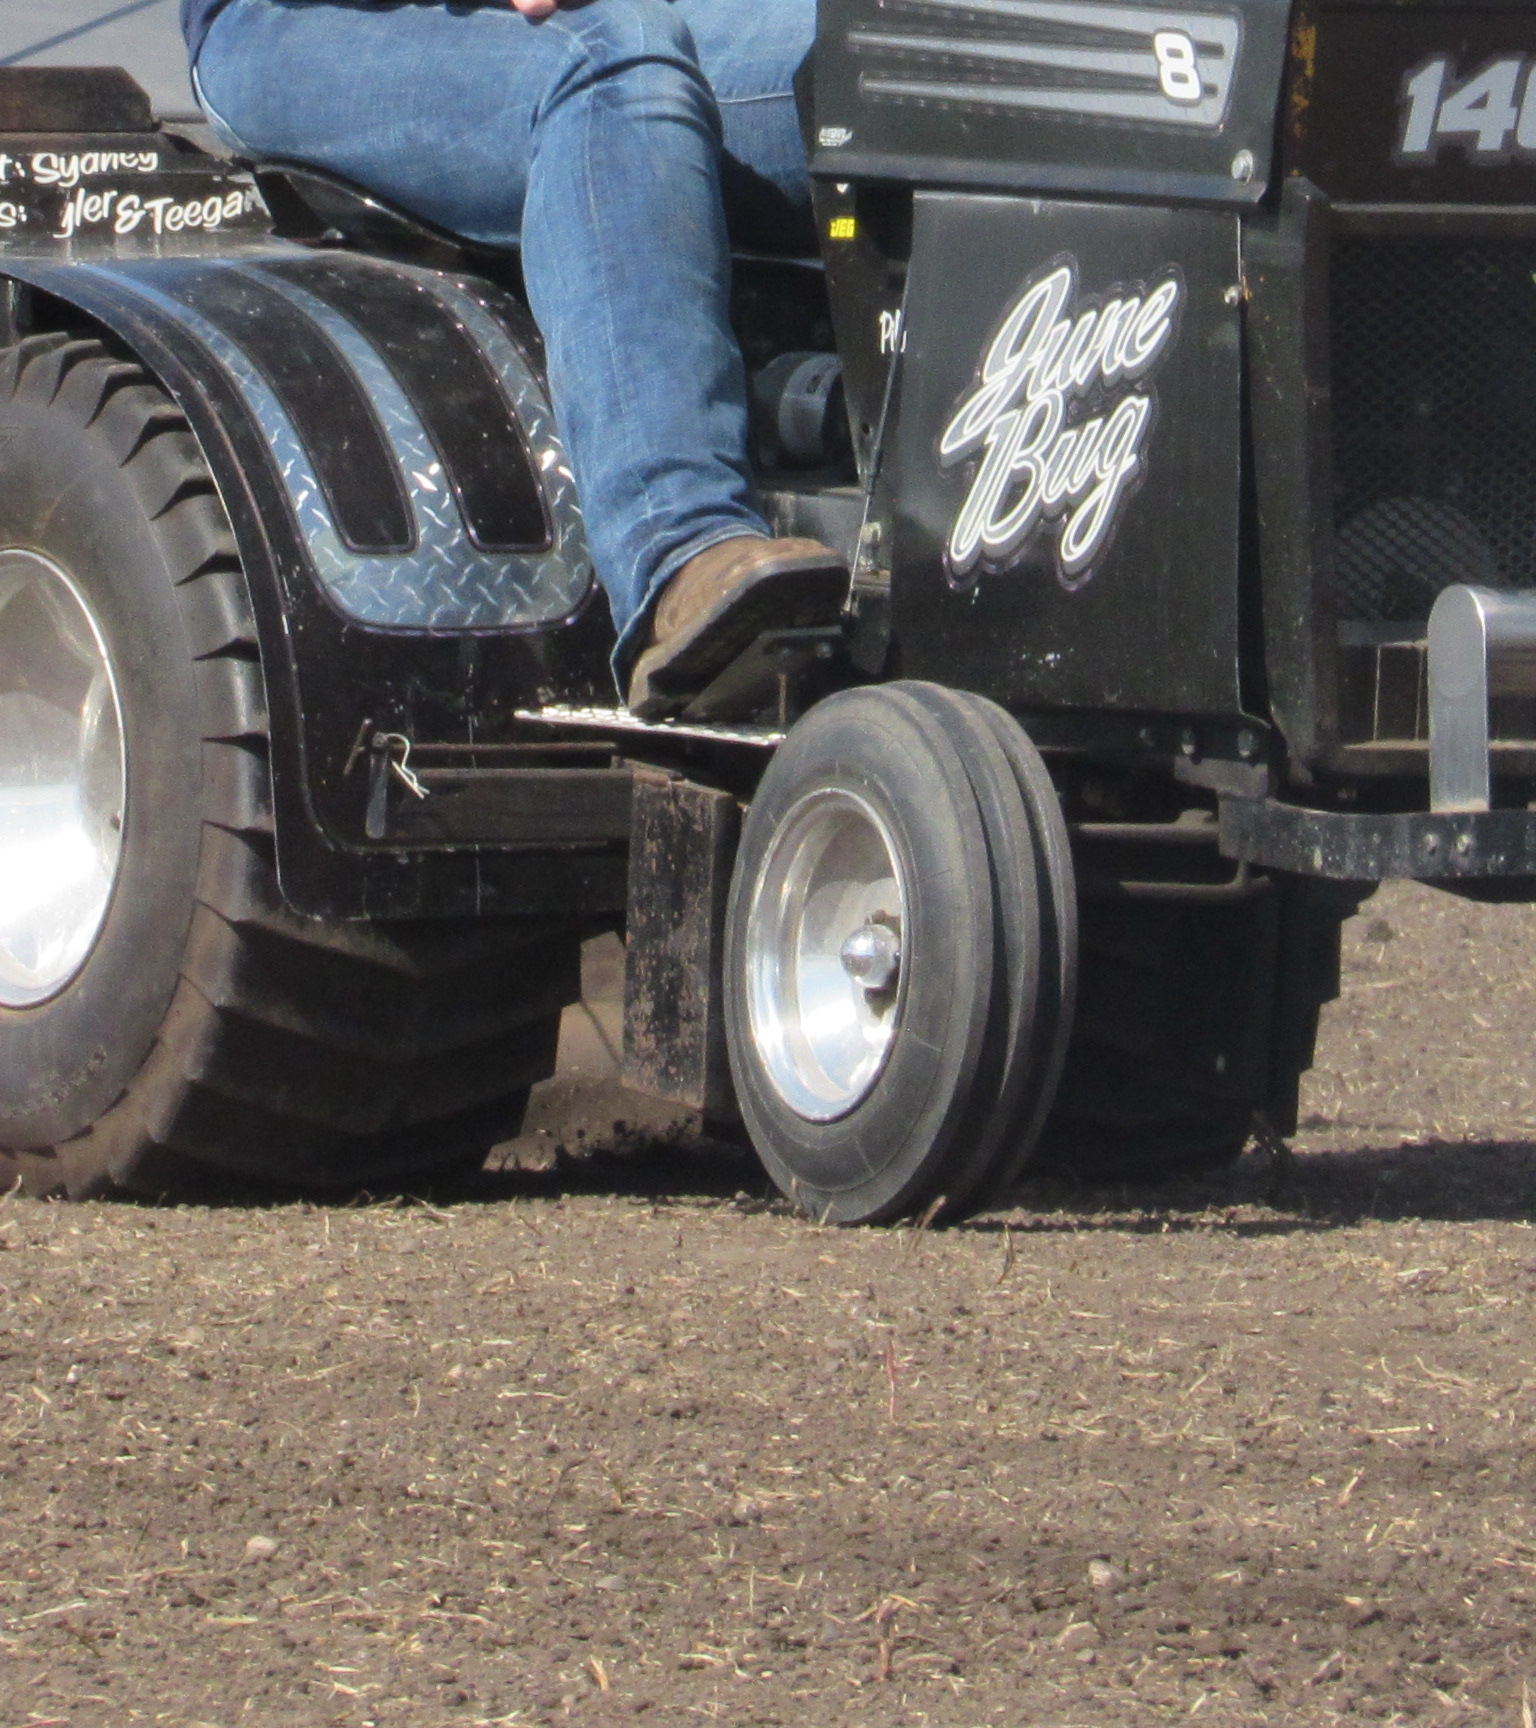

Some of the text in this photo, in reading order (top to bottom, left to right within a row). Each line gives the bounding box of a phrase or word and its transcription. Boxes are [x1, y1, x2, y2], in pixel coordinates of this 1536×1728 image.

[1154, 32, 1202, 101] 8
[940, 266, 1177, 454] June
[950, 388, 1150, 562] Bug
